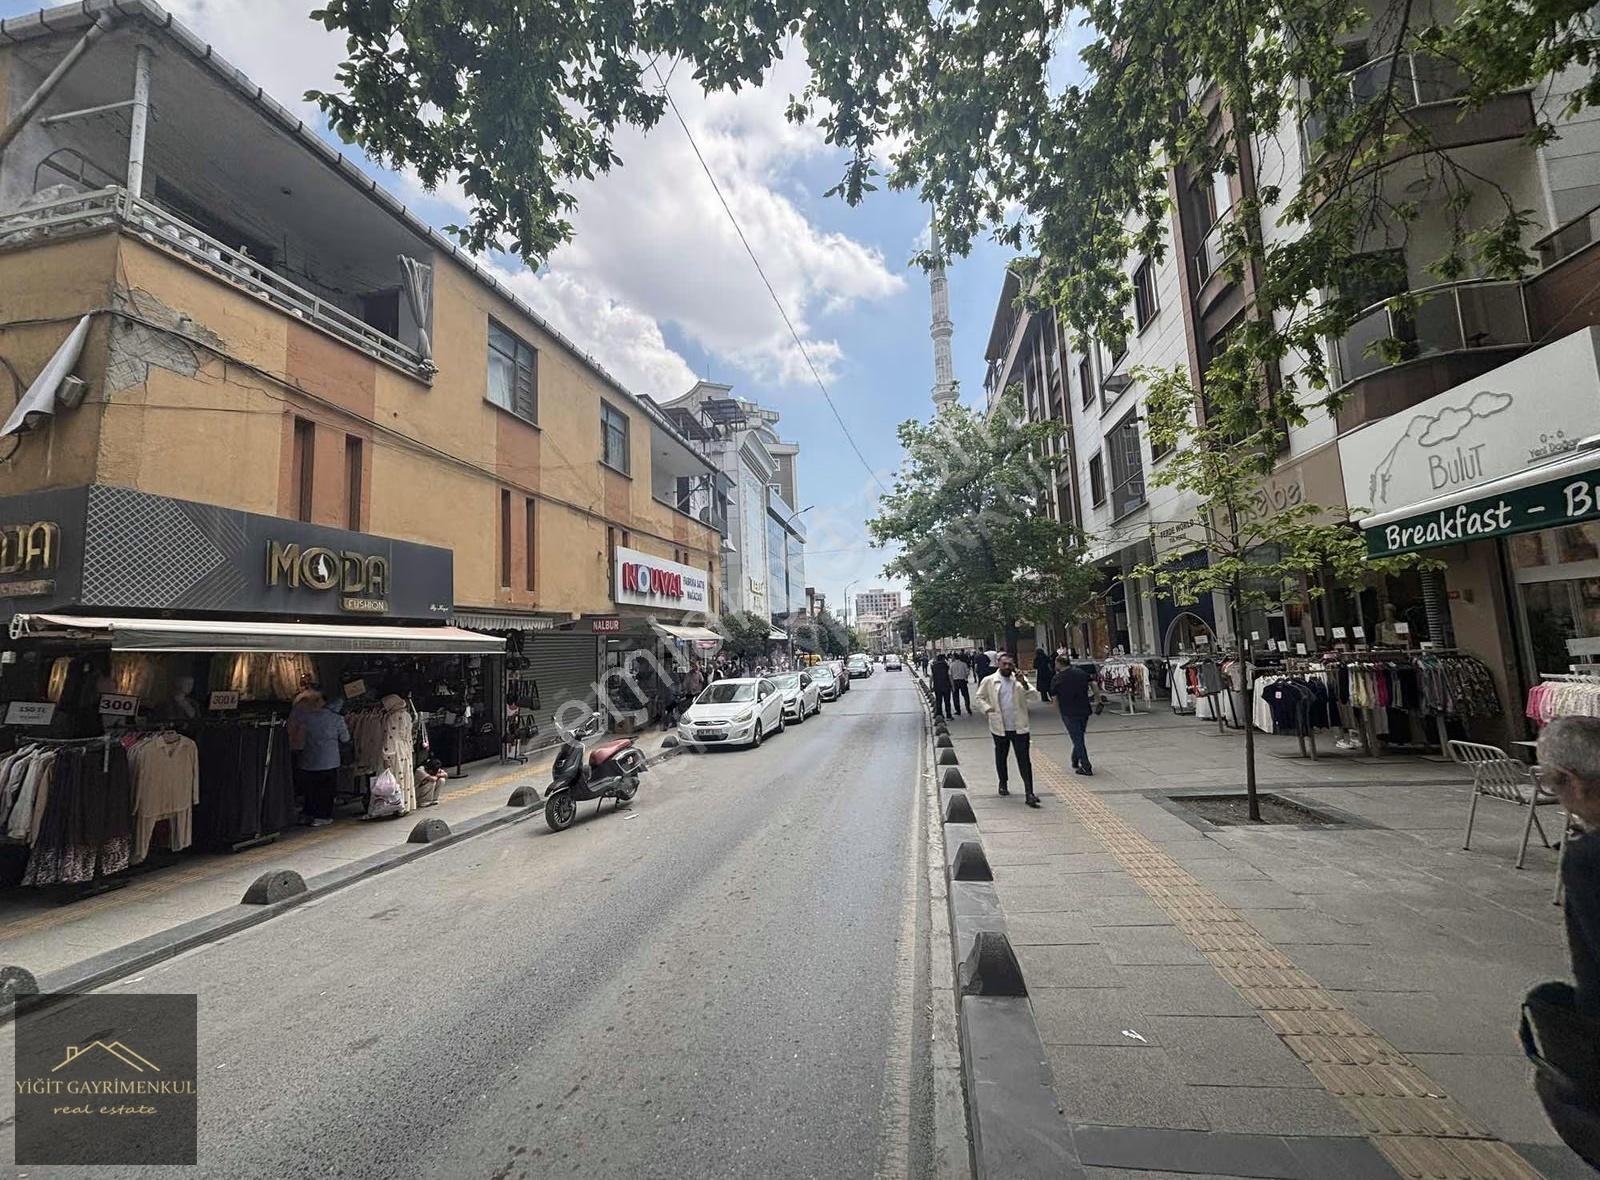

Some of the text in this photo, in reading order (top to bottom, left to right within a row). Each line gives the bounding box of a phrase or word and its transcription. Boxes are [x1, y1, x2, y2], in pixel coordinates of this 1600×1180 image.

[1386, 501, 1513, 550] Breakfast
[266, 539, 390, 595] MODA
[622, 561, 684, 598] NOUVAL
[592, 620, 619, 630] NALBUR
[101, 698, 133, 712] 300
